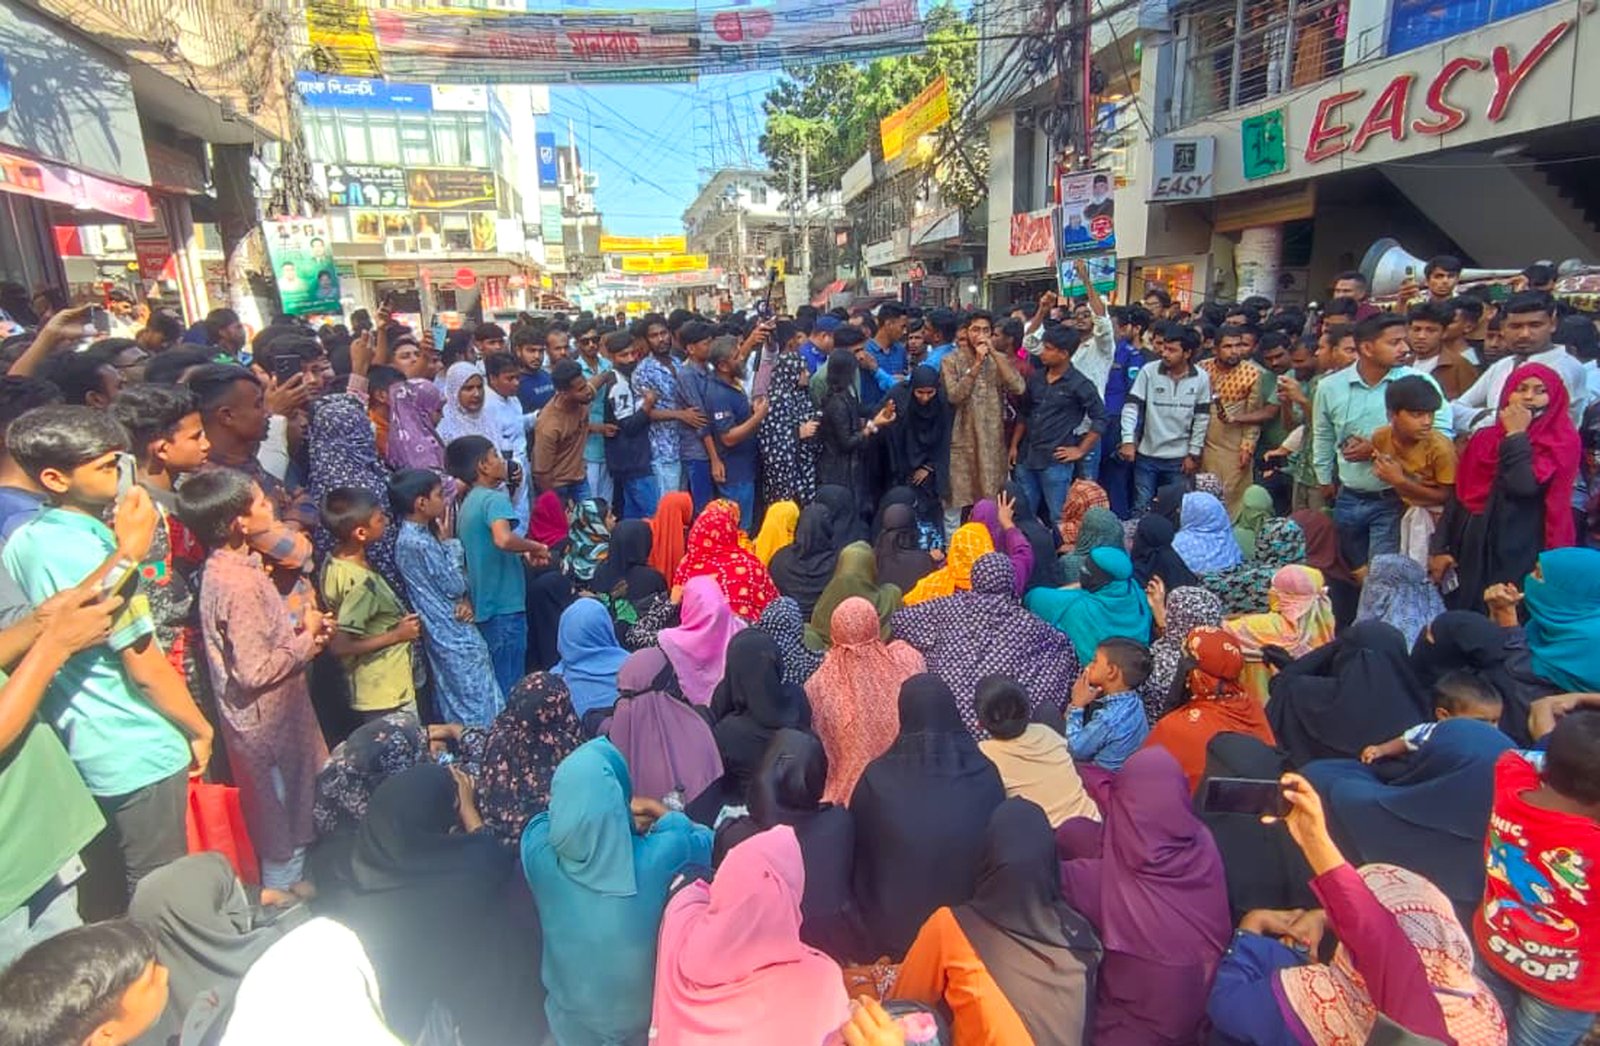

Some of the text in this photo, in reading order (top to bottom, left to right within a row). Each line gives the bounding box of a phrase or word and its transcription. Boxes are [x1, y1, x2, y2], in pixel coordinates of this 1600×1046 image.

[1304, 20, 1573, 164] EASY
[1153, 173, 1211, 198] EASY
[1488, 935, 1580, 982] STOP!
[1519, 939, 1578, 958] ON'T
